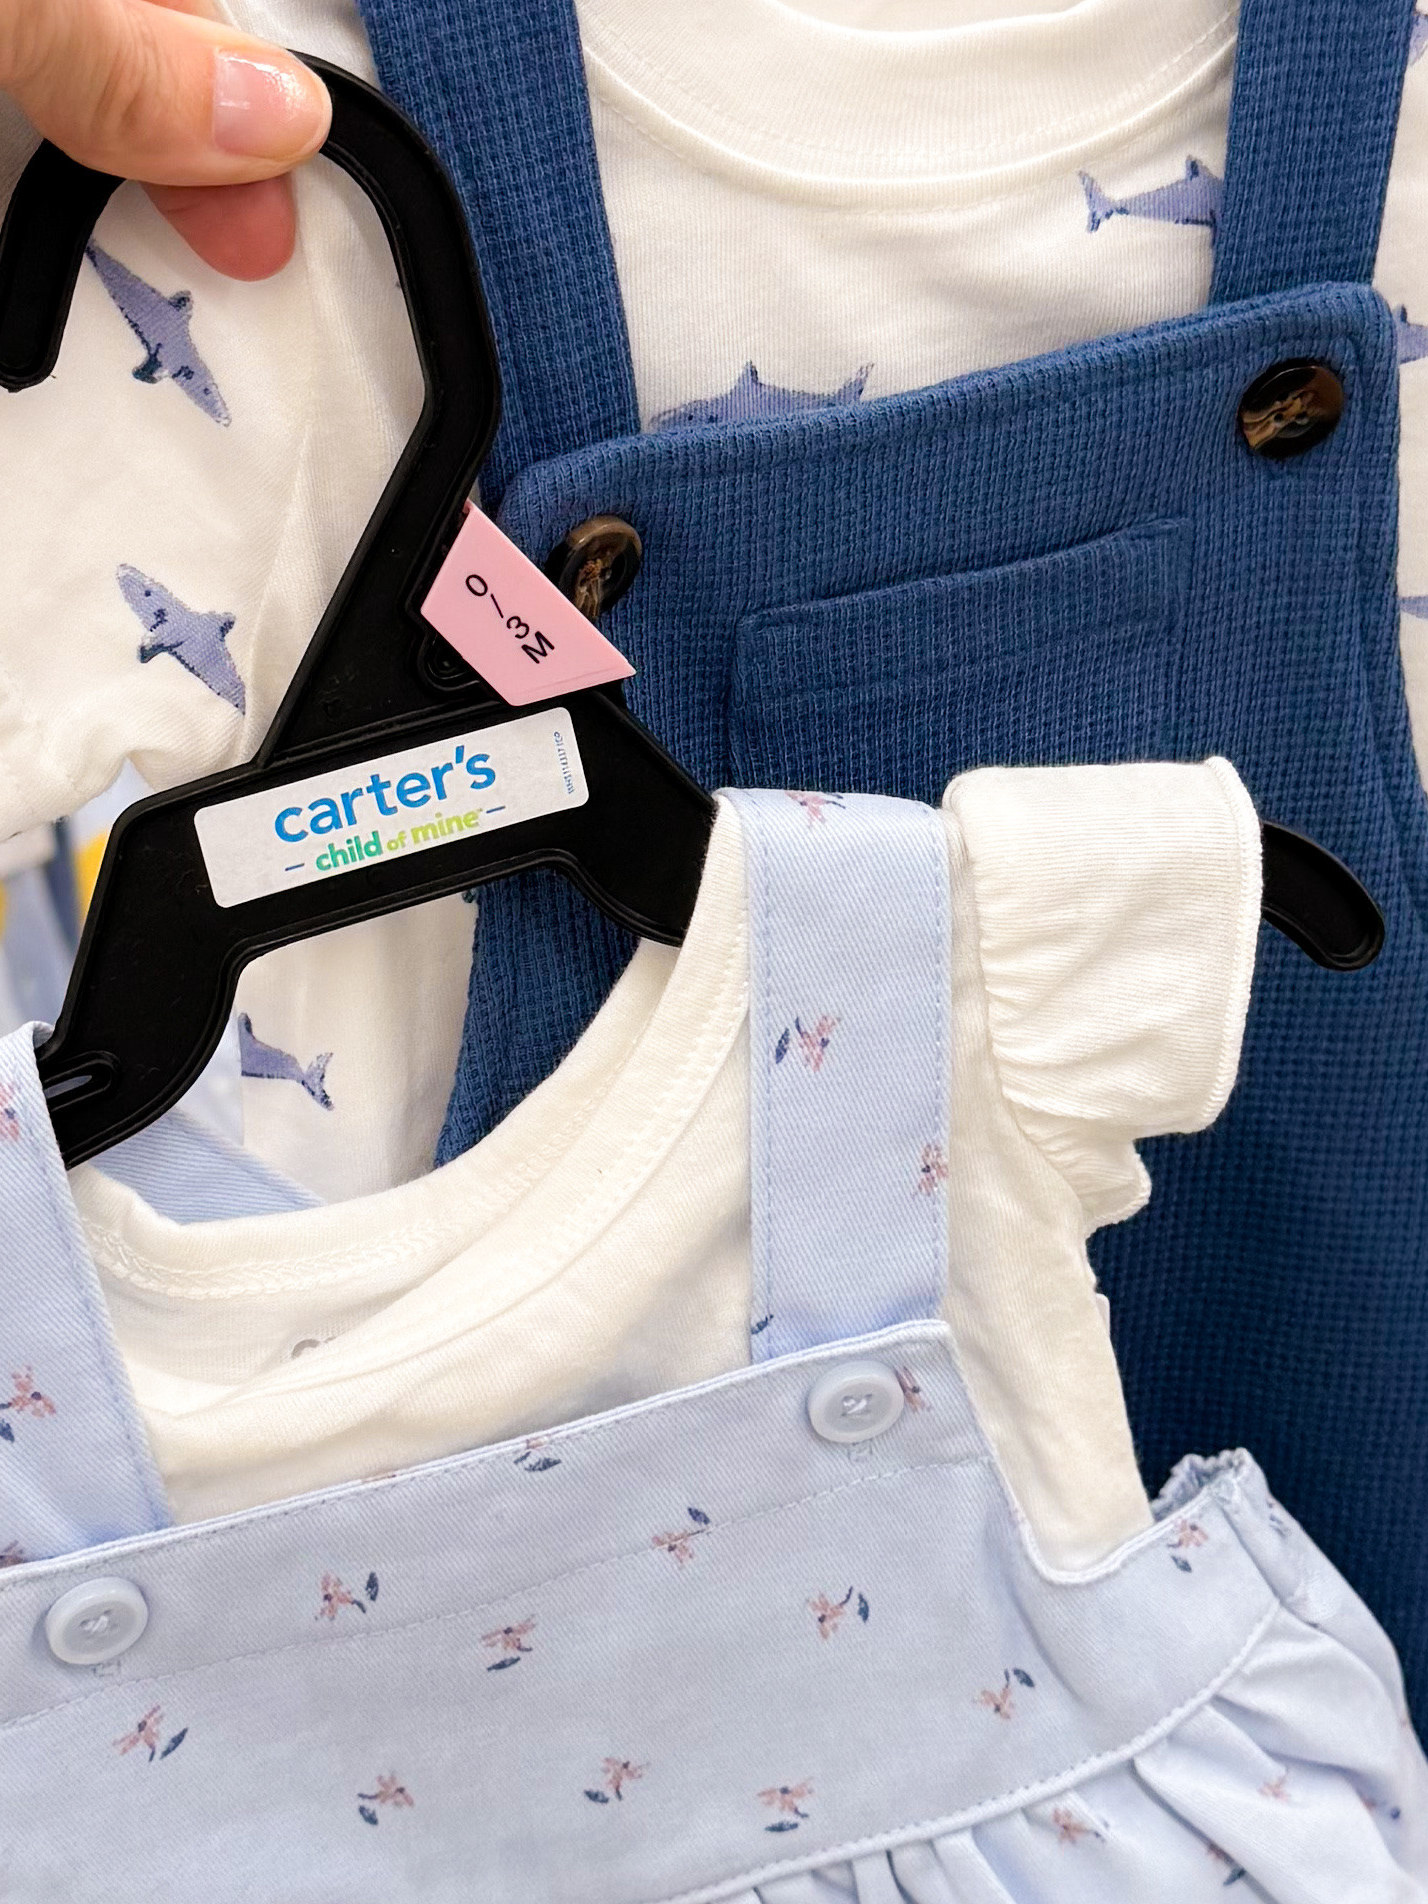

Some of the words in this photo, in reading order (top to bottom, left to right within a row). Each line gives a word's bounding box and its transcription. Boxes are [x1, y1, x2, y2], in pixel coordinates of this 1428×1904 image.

[274, 745, 496, 843] carter's
[315, 830, 384, 872] child
[386, 831, 408, 852] of
[411, 812, 481, 844] mine
